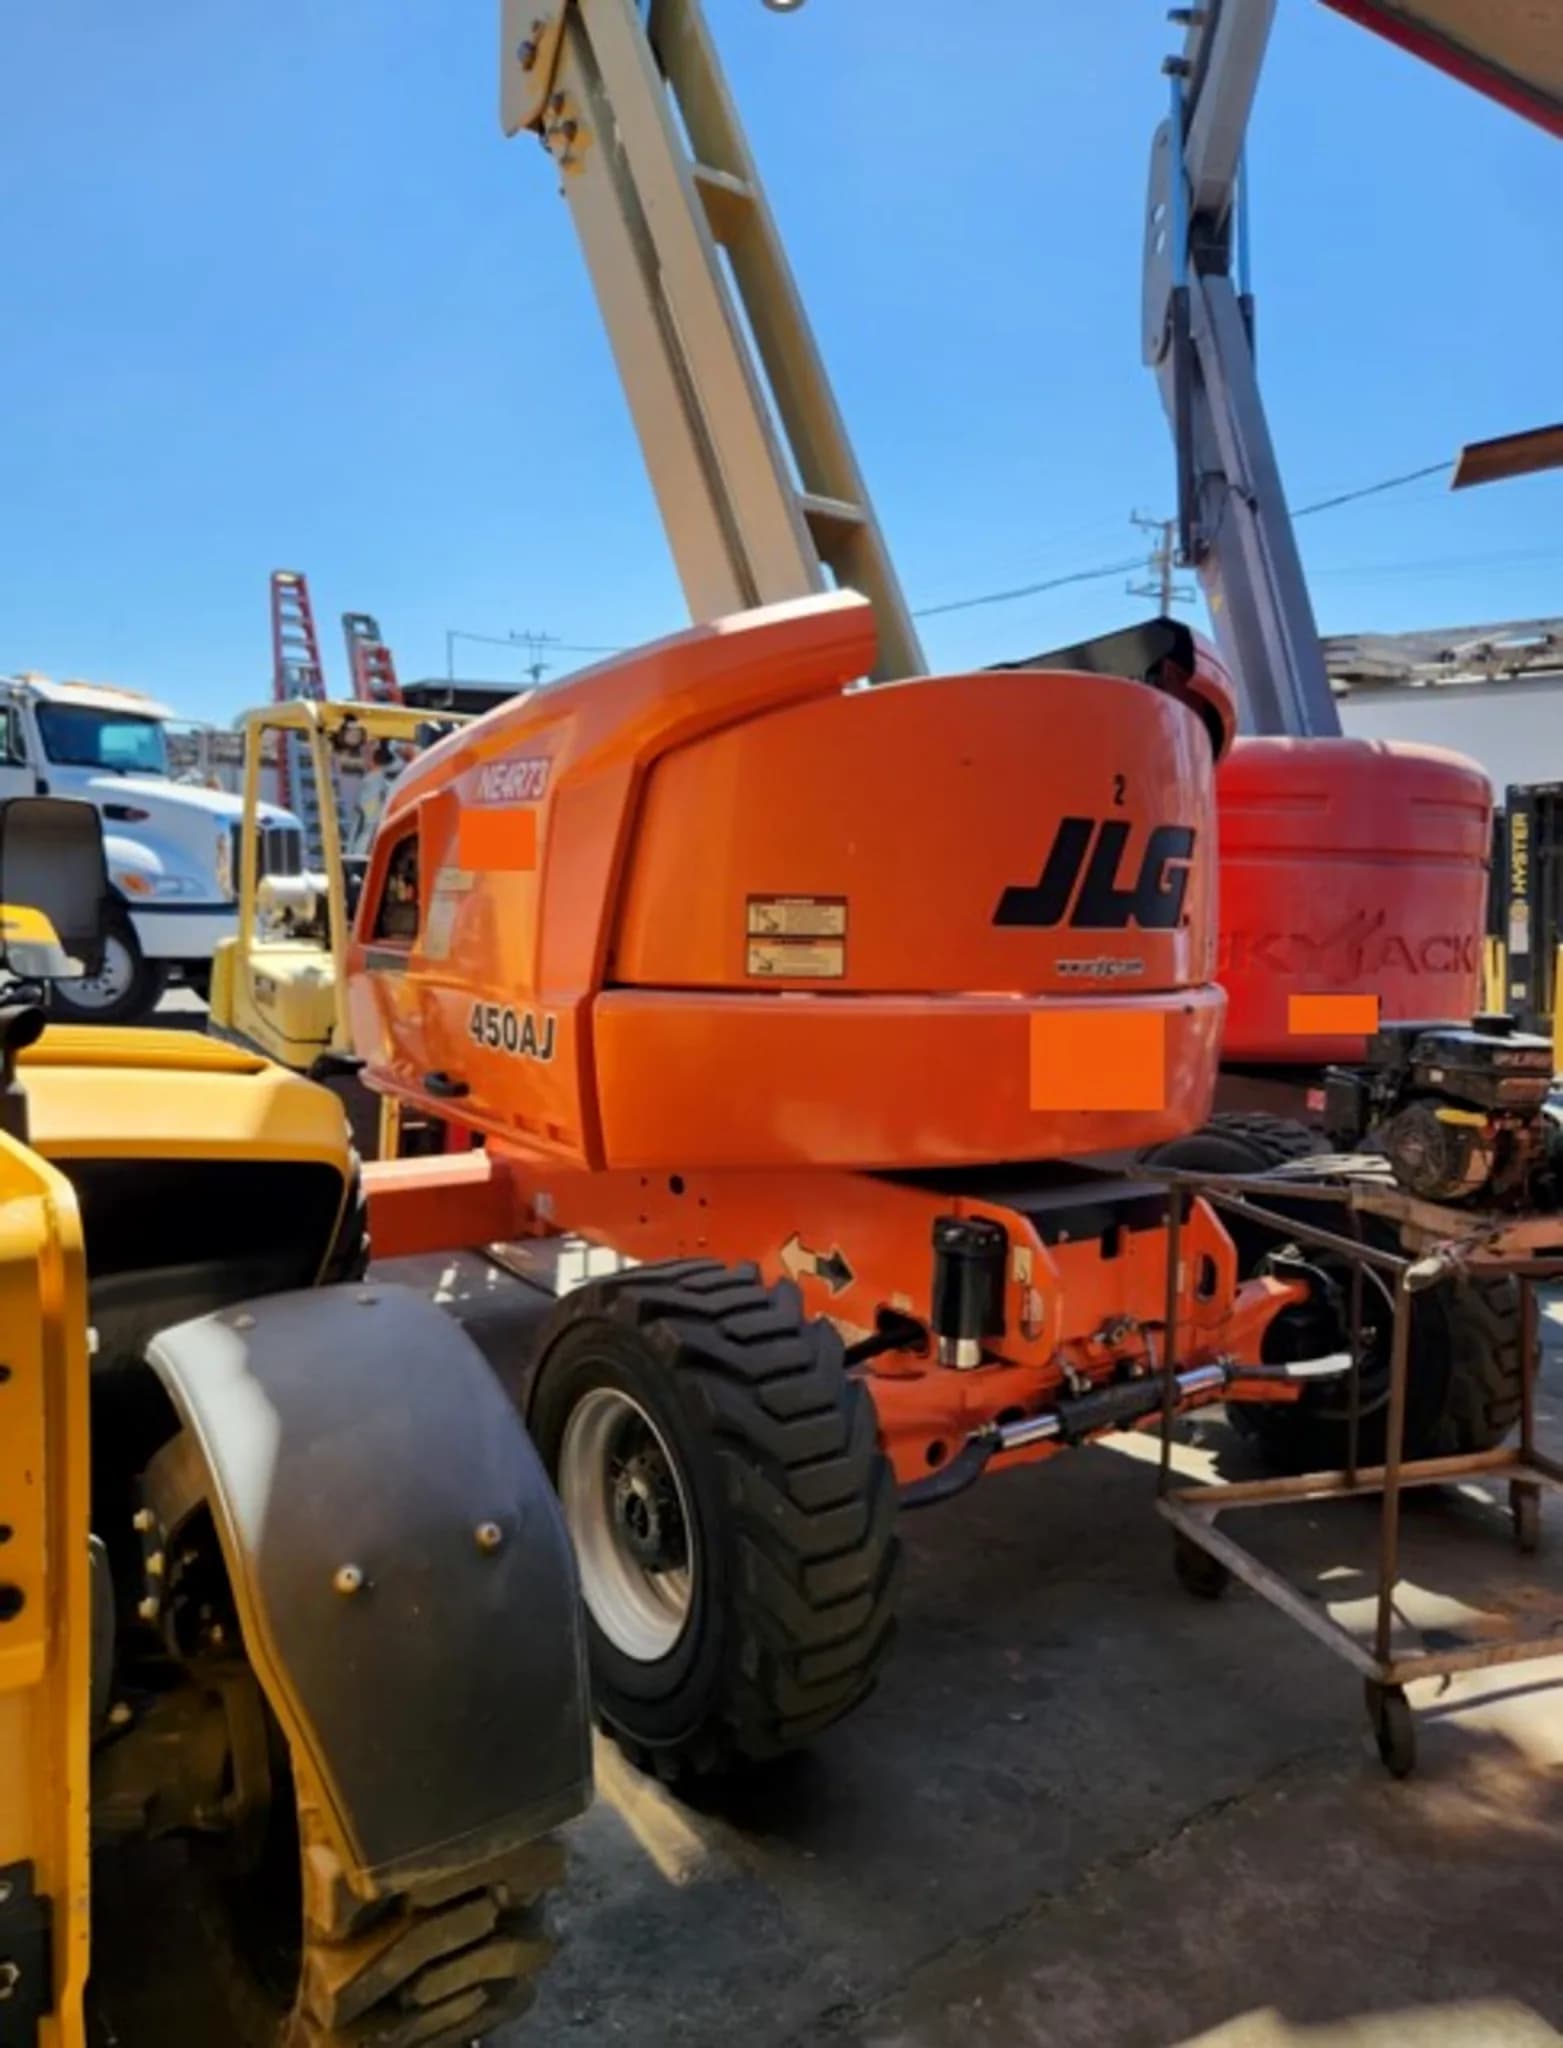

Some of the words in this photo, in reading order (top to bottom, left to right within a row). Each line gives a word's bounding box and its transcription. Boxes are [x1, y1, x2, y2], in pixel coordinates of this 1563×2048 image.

[1113, 774, 1126, 806] 2
[992, 816, 1196, 928] JLG
[1512, 813, 1528, 894] HYSTER
[470, 1003, 555, 1061] 450AJ
